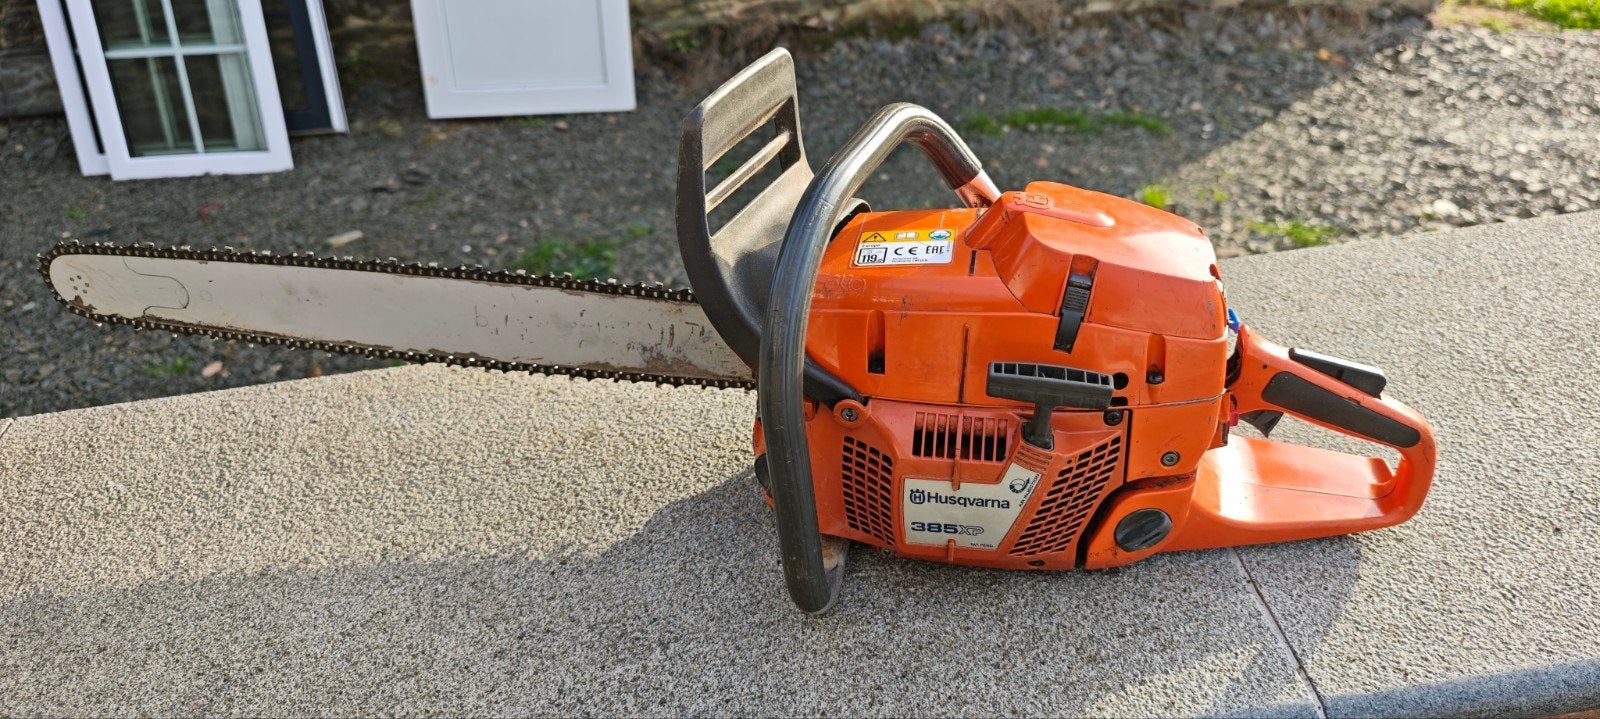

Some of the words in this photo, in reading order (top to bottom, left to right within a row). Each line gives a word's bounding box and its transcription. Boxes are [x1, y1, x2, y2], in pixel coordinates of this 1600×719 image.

[862, 254, 878, 263] 119
[927, 491, 1010, 509] Husqvarna
[911, 521, 985, 536] 385XP
